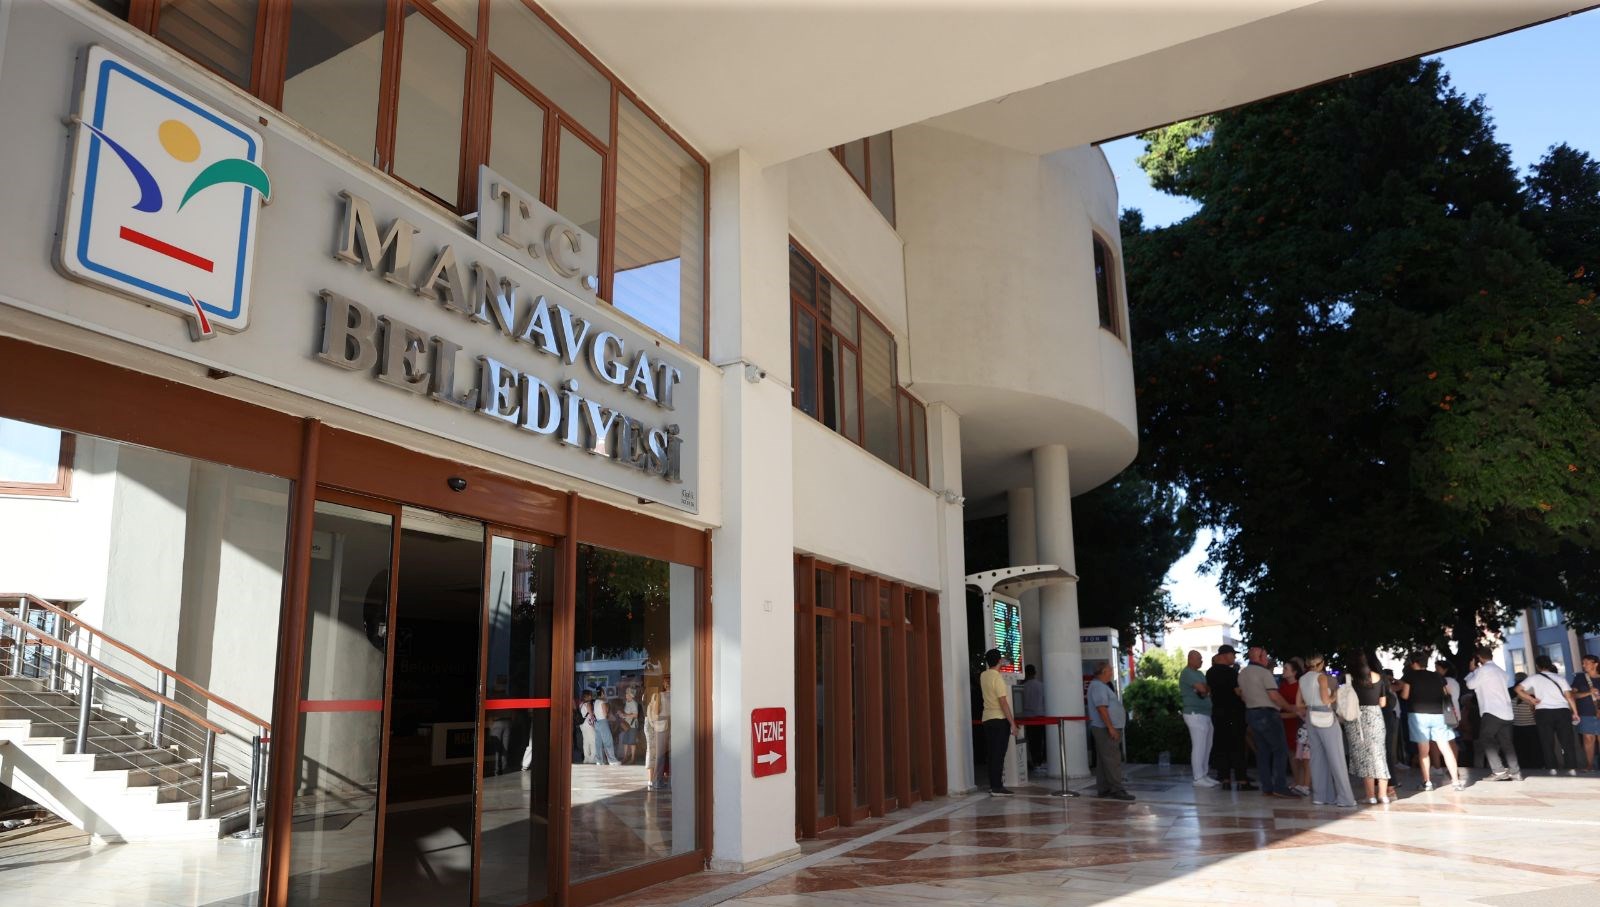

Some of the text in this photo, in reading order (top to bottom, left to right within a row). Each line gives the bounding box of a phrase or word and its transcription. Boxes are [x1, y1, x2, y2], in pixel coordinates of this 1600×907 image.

[334, 189, 681, 411] MANAVGAT
[492, 183, 598, 290] T.C.
[318, 289, 684, 484] BELEDİYESİ
[754, 721, 784, 743] VEZNE
